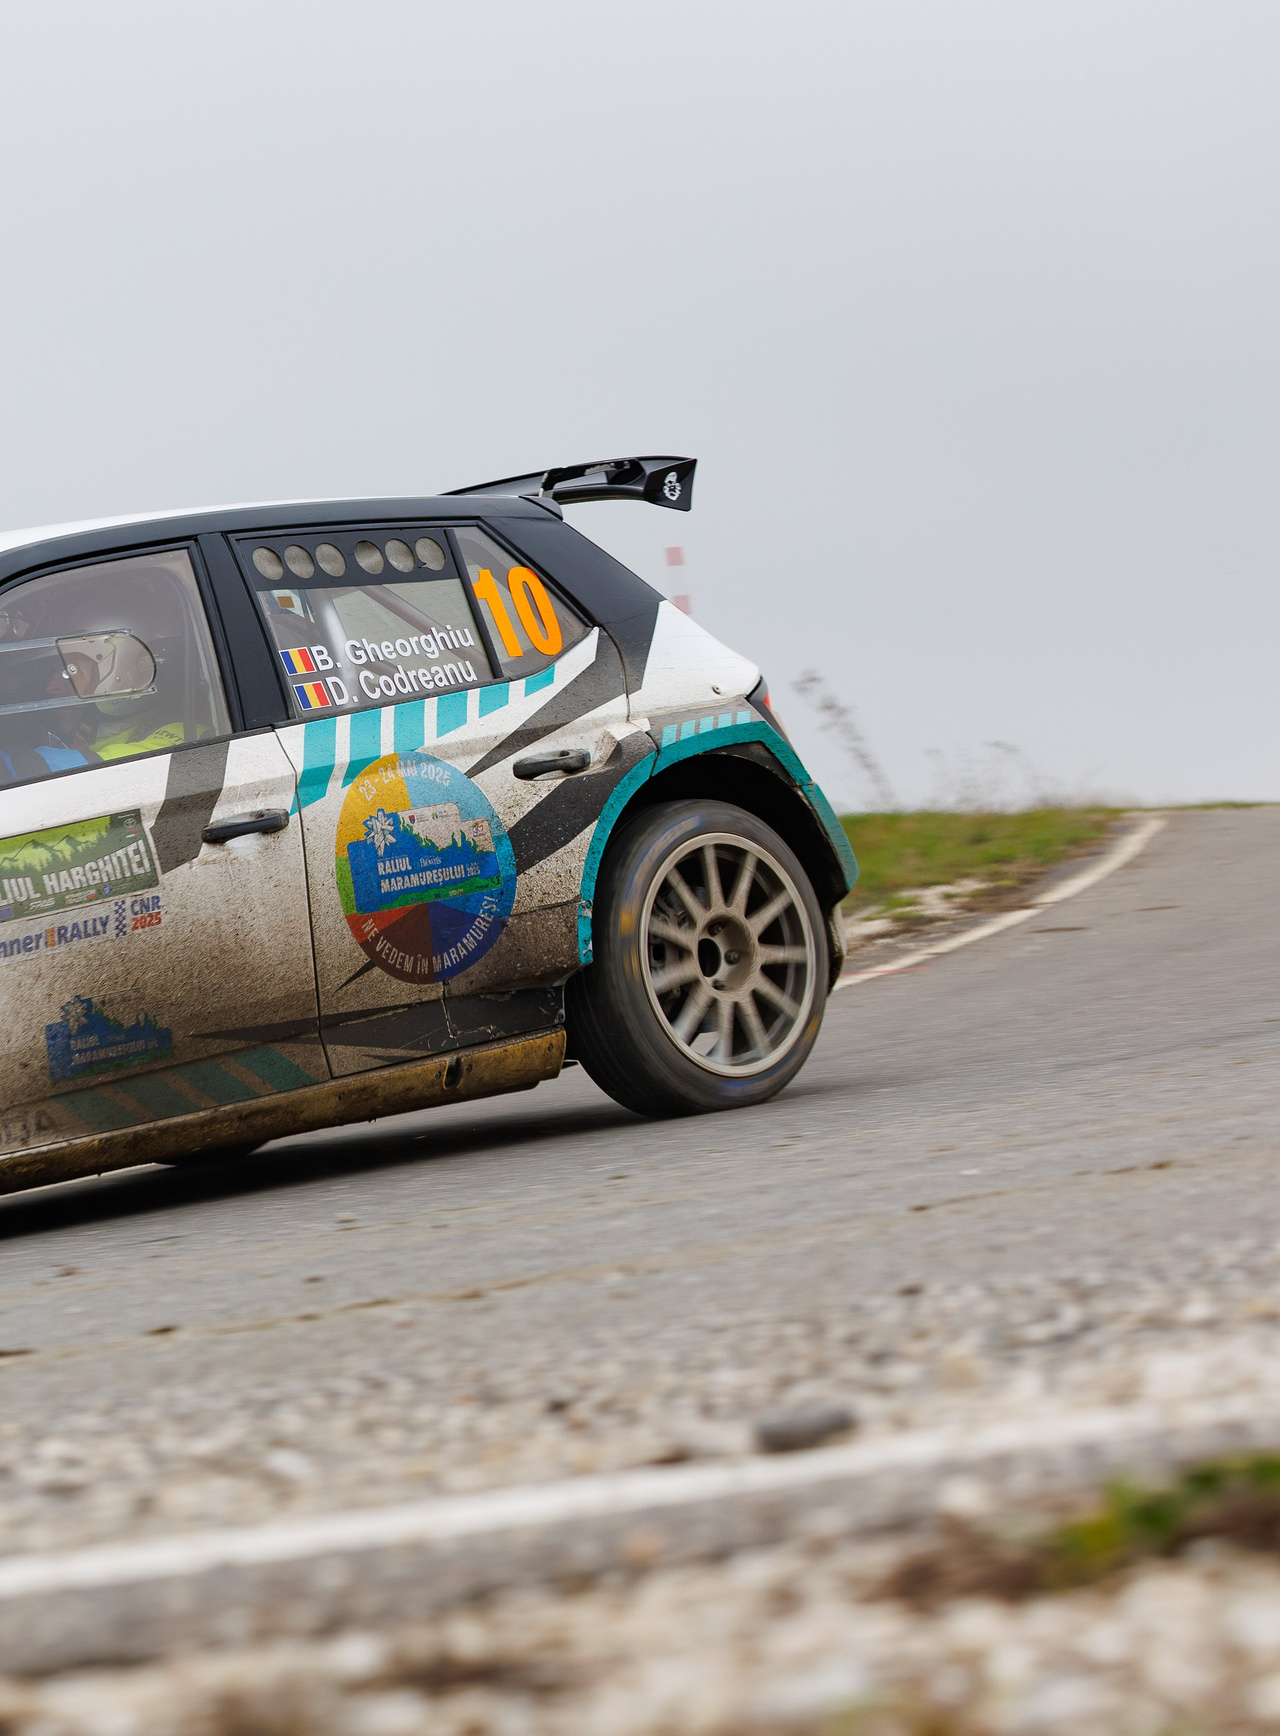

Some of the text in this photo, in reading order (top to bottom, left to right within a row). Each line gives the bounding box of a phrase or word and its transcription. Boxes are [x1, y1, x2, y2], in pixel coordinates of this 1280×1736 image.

[472, 565, 564, 658] 10
[309, 624, 476, 671] B. Gheorghiu
[325, 660, 478, 706] D. Codreanu
[359, 779, 377, 802] 23
[378, 763, 396, 784] 24
[395, 759, 418, 779] MAI
[421, 761, 451, 787] 2025
[41, 839, 152, 896] HARGHITEI
[377, 857, 412, 876] RALIUL
[130, 895, 162, 916] CNR
[130, 911, 163, 932] 2025
[57, 915, 111, 945] RALLY
[361, 918, 380, 942] NE
[375, 936, 414, 974] VEDEM
[416, 954, 429, 975] ÎN
